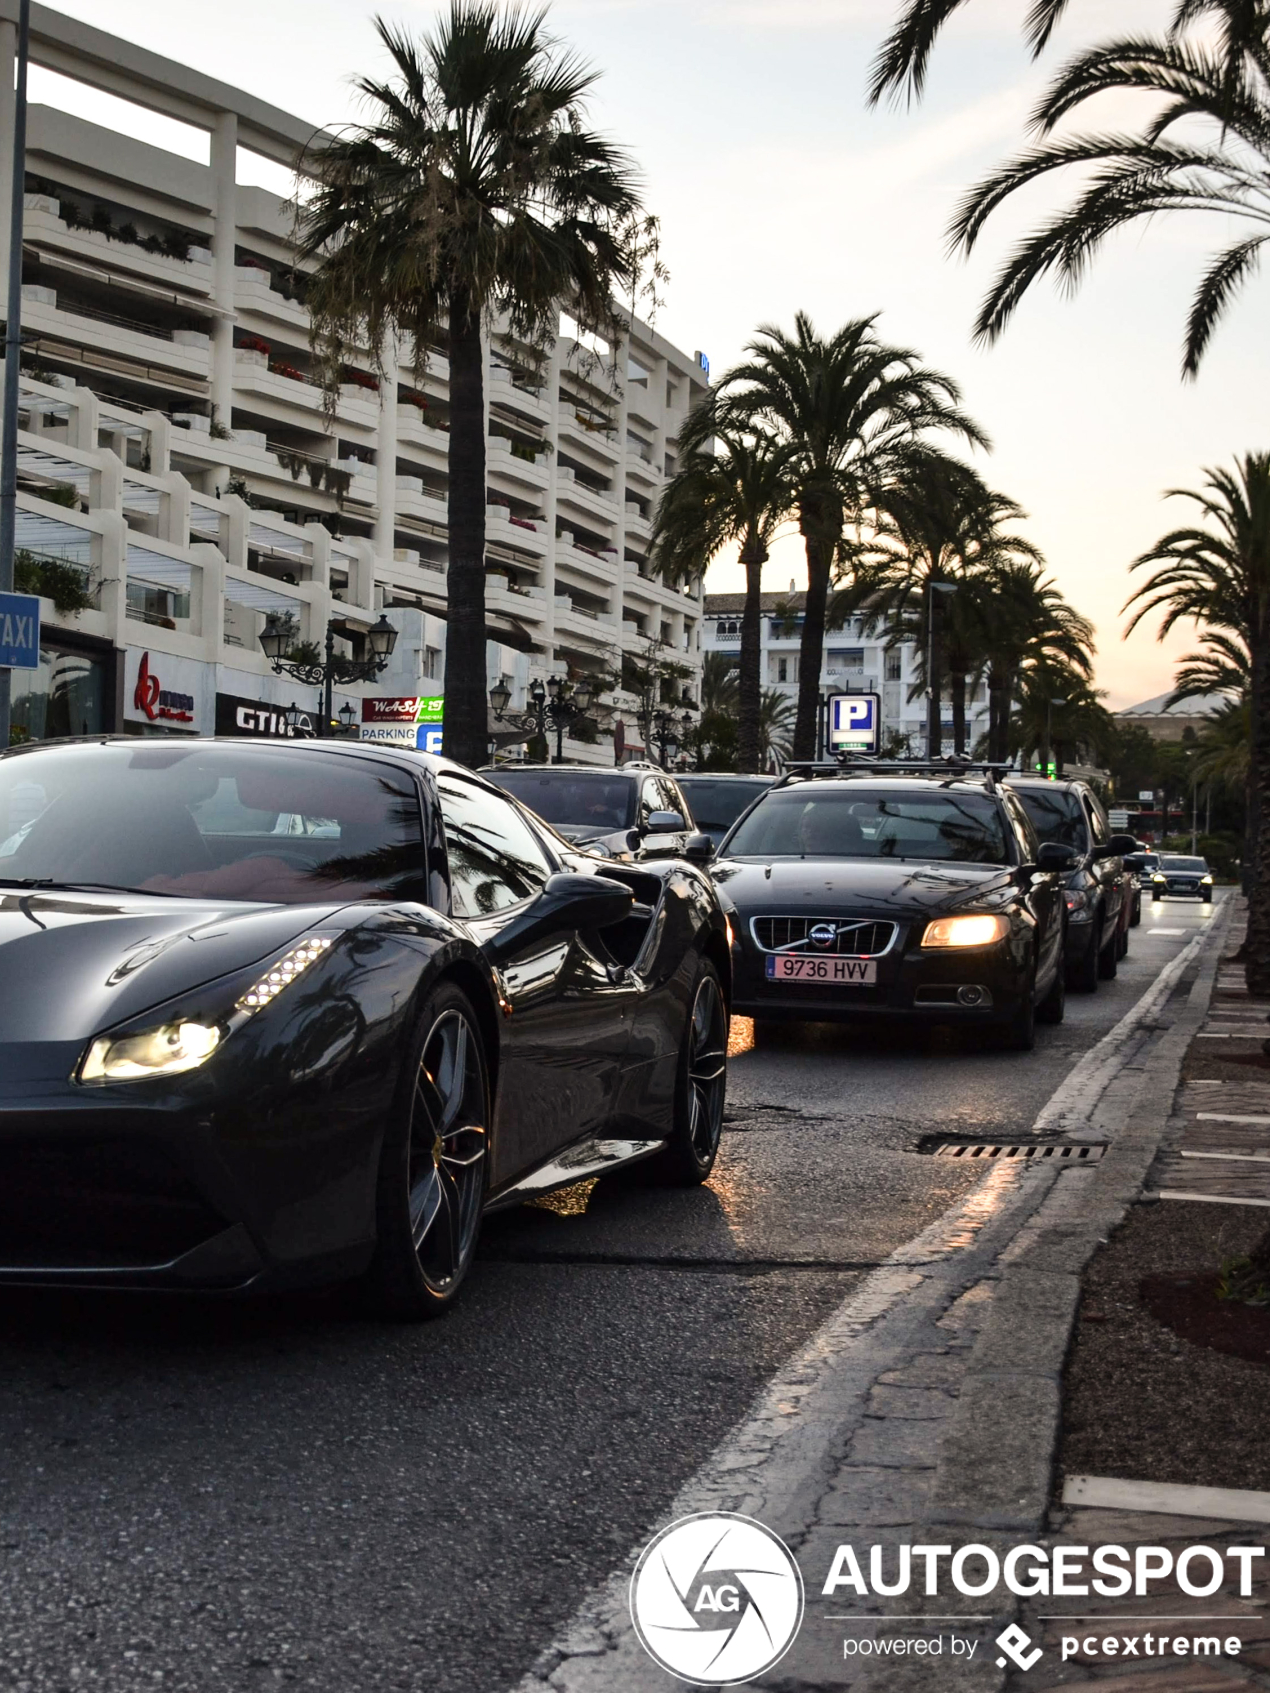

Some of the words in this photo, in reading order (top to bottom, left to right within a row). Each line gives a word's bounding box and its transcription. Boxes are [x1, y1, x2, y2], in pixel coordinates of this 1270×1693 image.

[373, 698, 427, 714] WASH
[839, 701, 868, 730] P
[362, 729, 415, 740] PARKING
[783, 960, 828, 977] 9736
[834, 962, 869, 979] HVV
